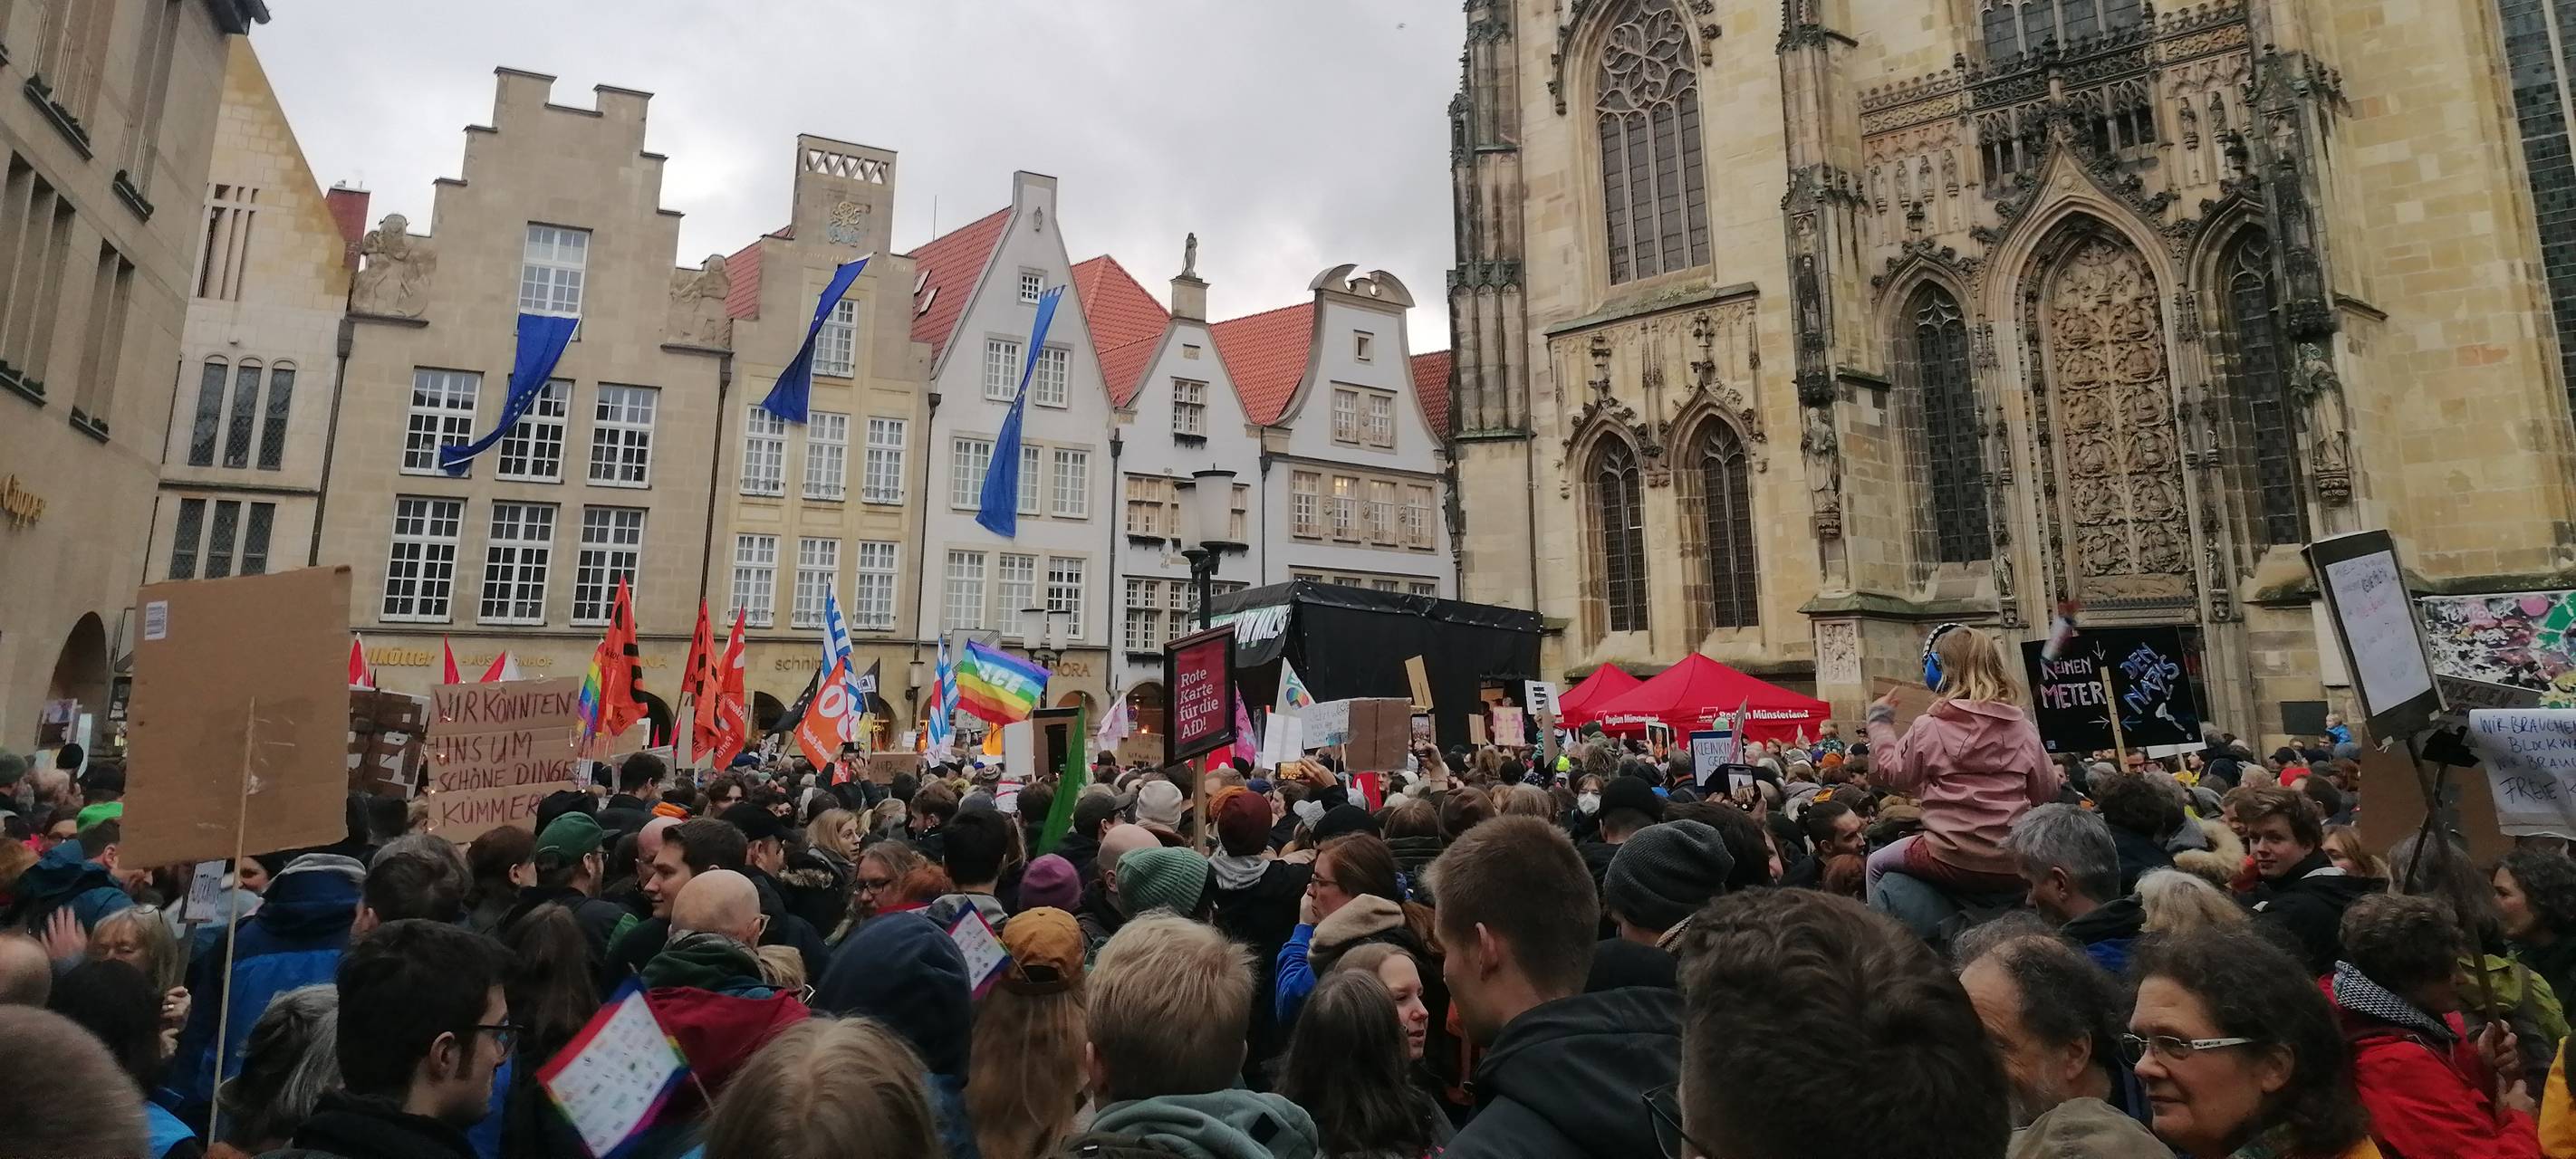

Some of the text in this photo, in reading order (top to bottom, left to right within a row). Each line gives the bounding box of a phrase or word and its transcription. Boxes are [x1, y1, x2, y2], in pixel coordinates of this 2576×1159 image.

[1180, 668, 1207, 688] Rote
[435, 691, 477, 723] WIR
[484, 687, 572, 724] KÖNNTEN
[1179, 684, 1214, 704] Karte
[2040, 681, 2107, 710] METER
[1179, 697, 1219, 722] für die
[1606, 713, 1659, 725] Region Münsterland
[1719, 710, 1751, 723] Regn
[1753, 709, 1810, 721] Münsterland
[1181, 716, 1207, 739] AfD!
[435, 731, 533, 766] UNS UM
[437, 759, 577, 792] SCHÖNE DINGE
[2500, 775, 2557, 804] FREIE
[442, 793, 543, 827] KÜMMER
